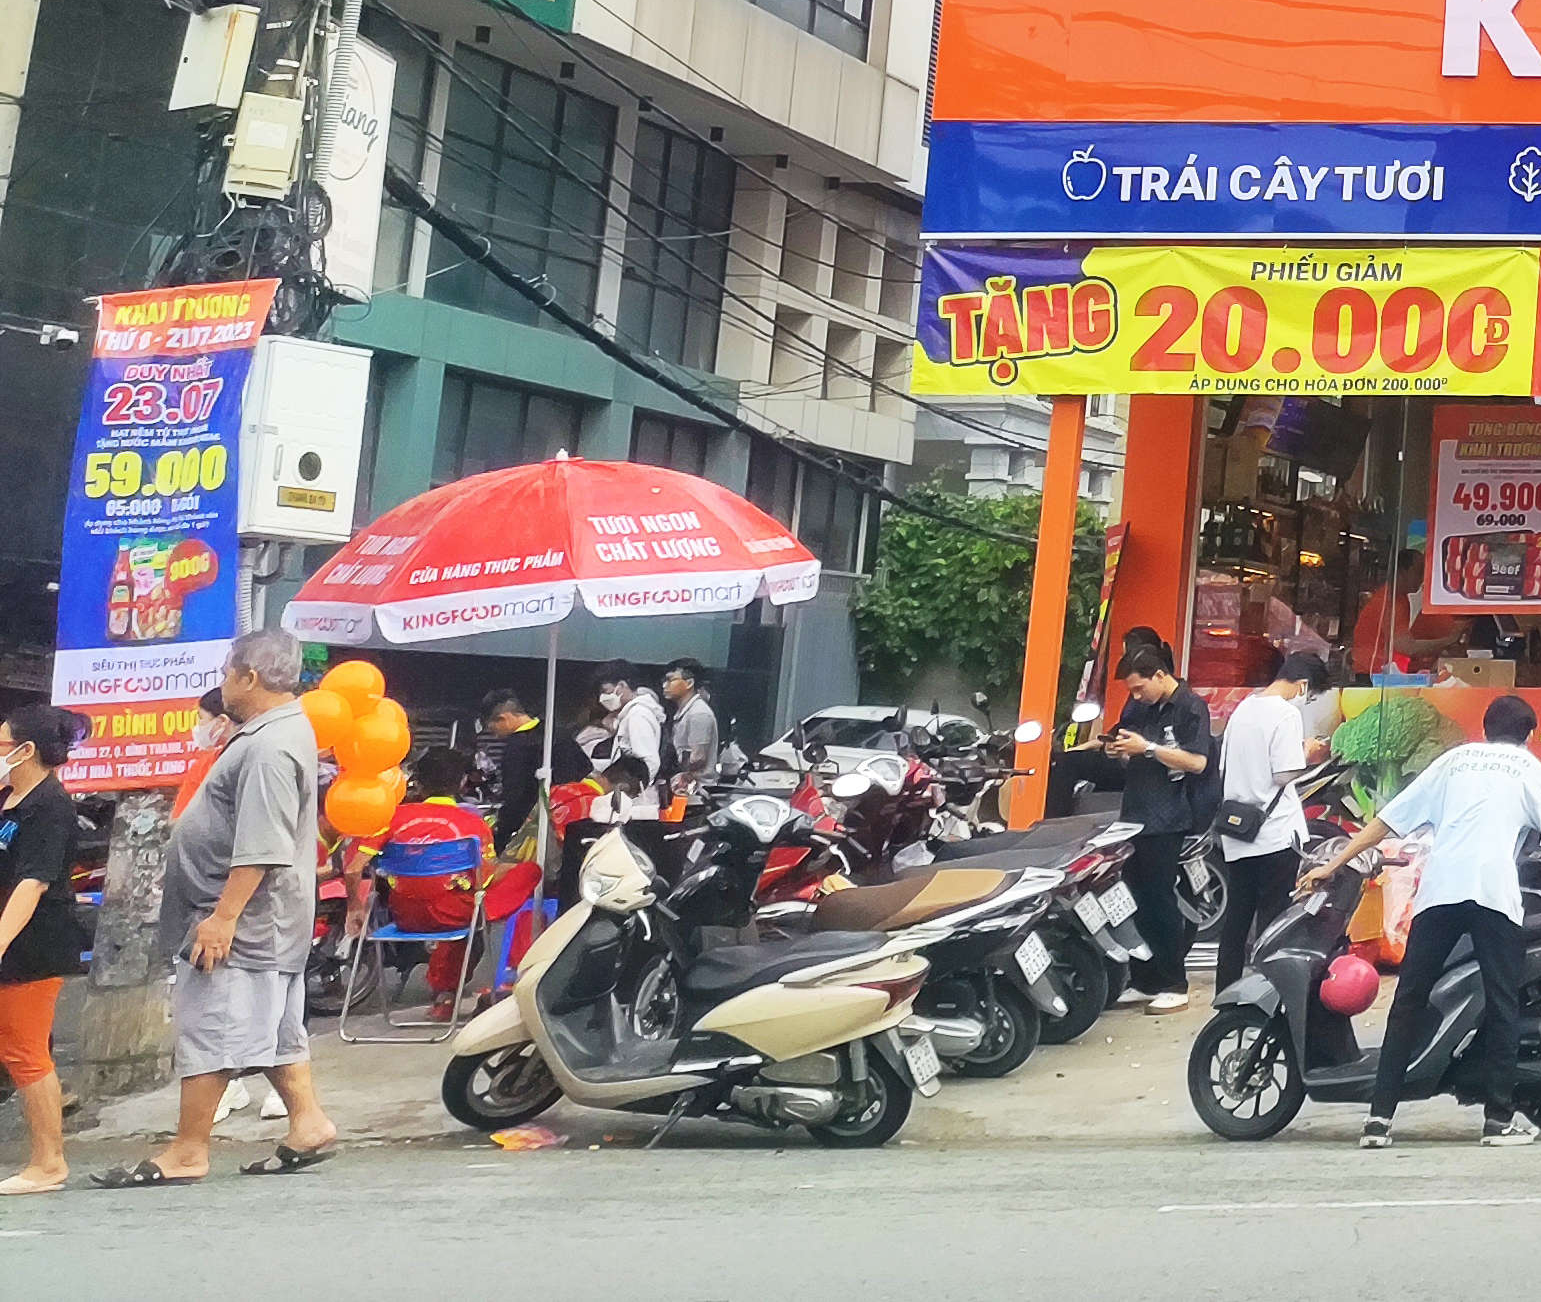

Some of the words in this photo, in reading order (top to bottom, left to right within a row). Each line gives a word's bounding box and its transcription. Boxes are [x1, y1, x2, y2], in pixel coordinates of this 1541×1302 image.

[1112, 154, 1218, 202] TRÁI
[1229, 156, 1330, 201] CÂY
[1335, 159, 1445, 202] TƯƠI
[1251, 255, 1330, 282] PHIẾU
[1336, 258, 1402, 283] GIẢM
[114, 301, 167, 326] KHAI
[173, 294, 251, 322] TRƯƠNG
[939, 276, 1118, 386] TẶNG
[124, 364, 170, 381] DUY
[170, 355, 213, 382] NHẤT
[102, 377, 223, 426] 23.07
[85, 445, 228, 498] 59.000
[587, 514, 639, 537] TƯƠI
[643, 510, 701, 534] NGON
[596, 537, 650, 563] CHẤT
[653, 536, 721, 561] LƯỢNG
[409, 566, 440, 585] CỬA
[442, 561, 481, 582] HÀNG
[484, 556, 521, 578] THỰC
[524, 548, 564, 572] PHẨM
[92, 656, 115, 671] SIÊU
